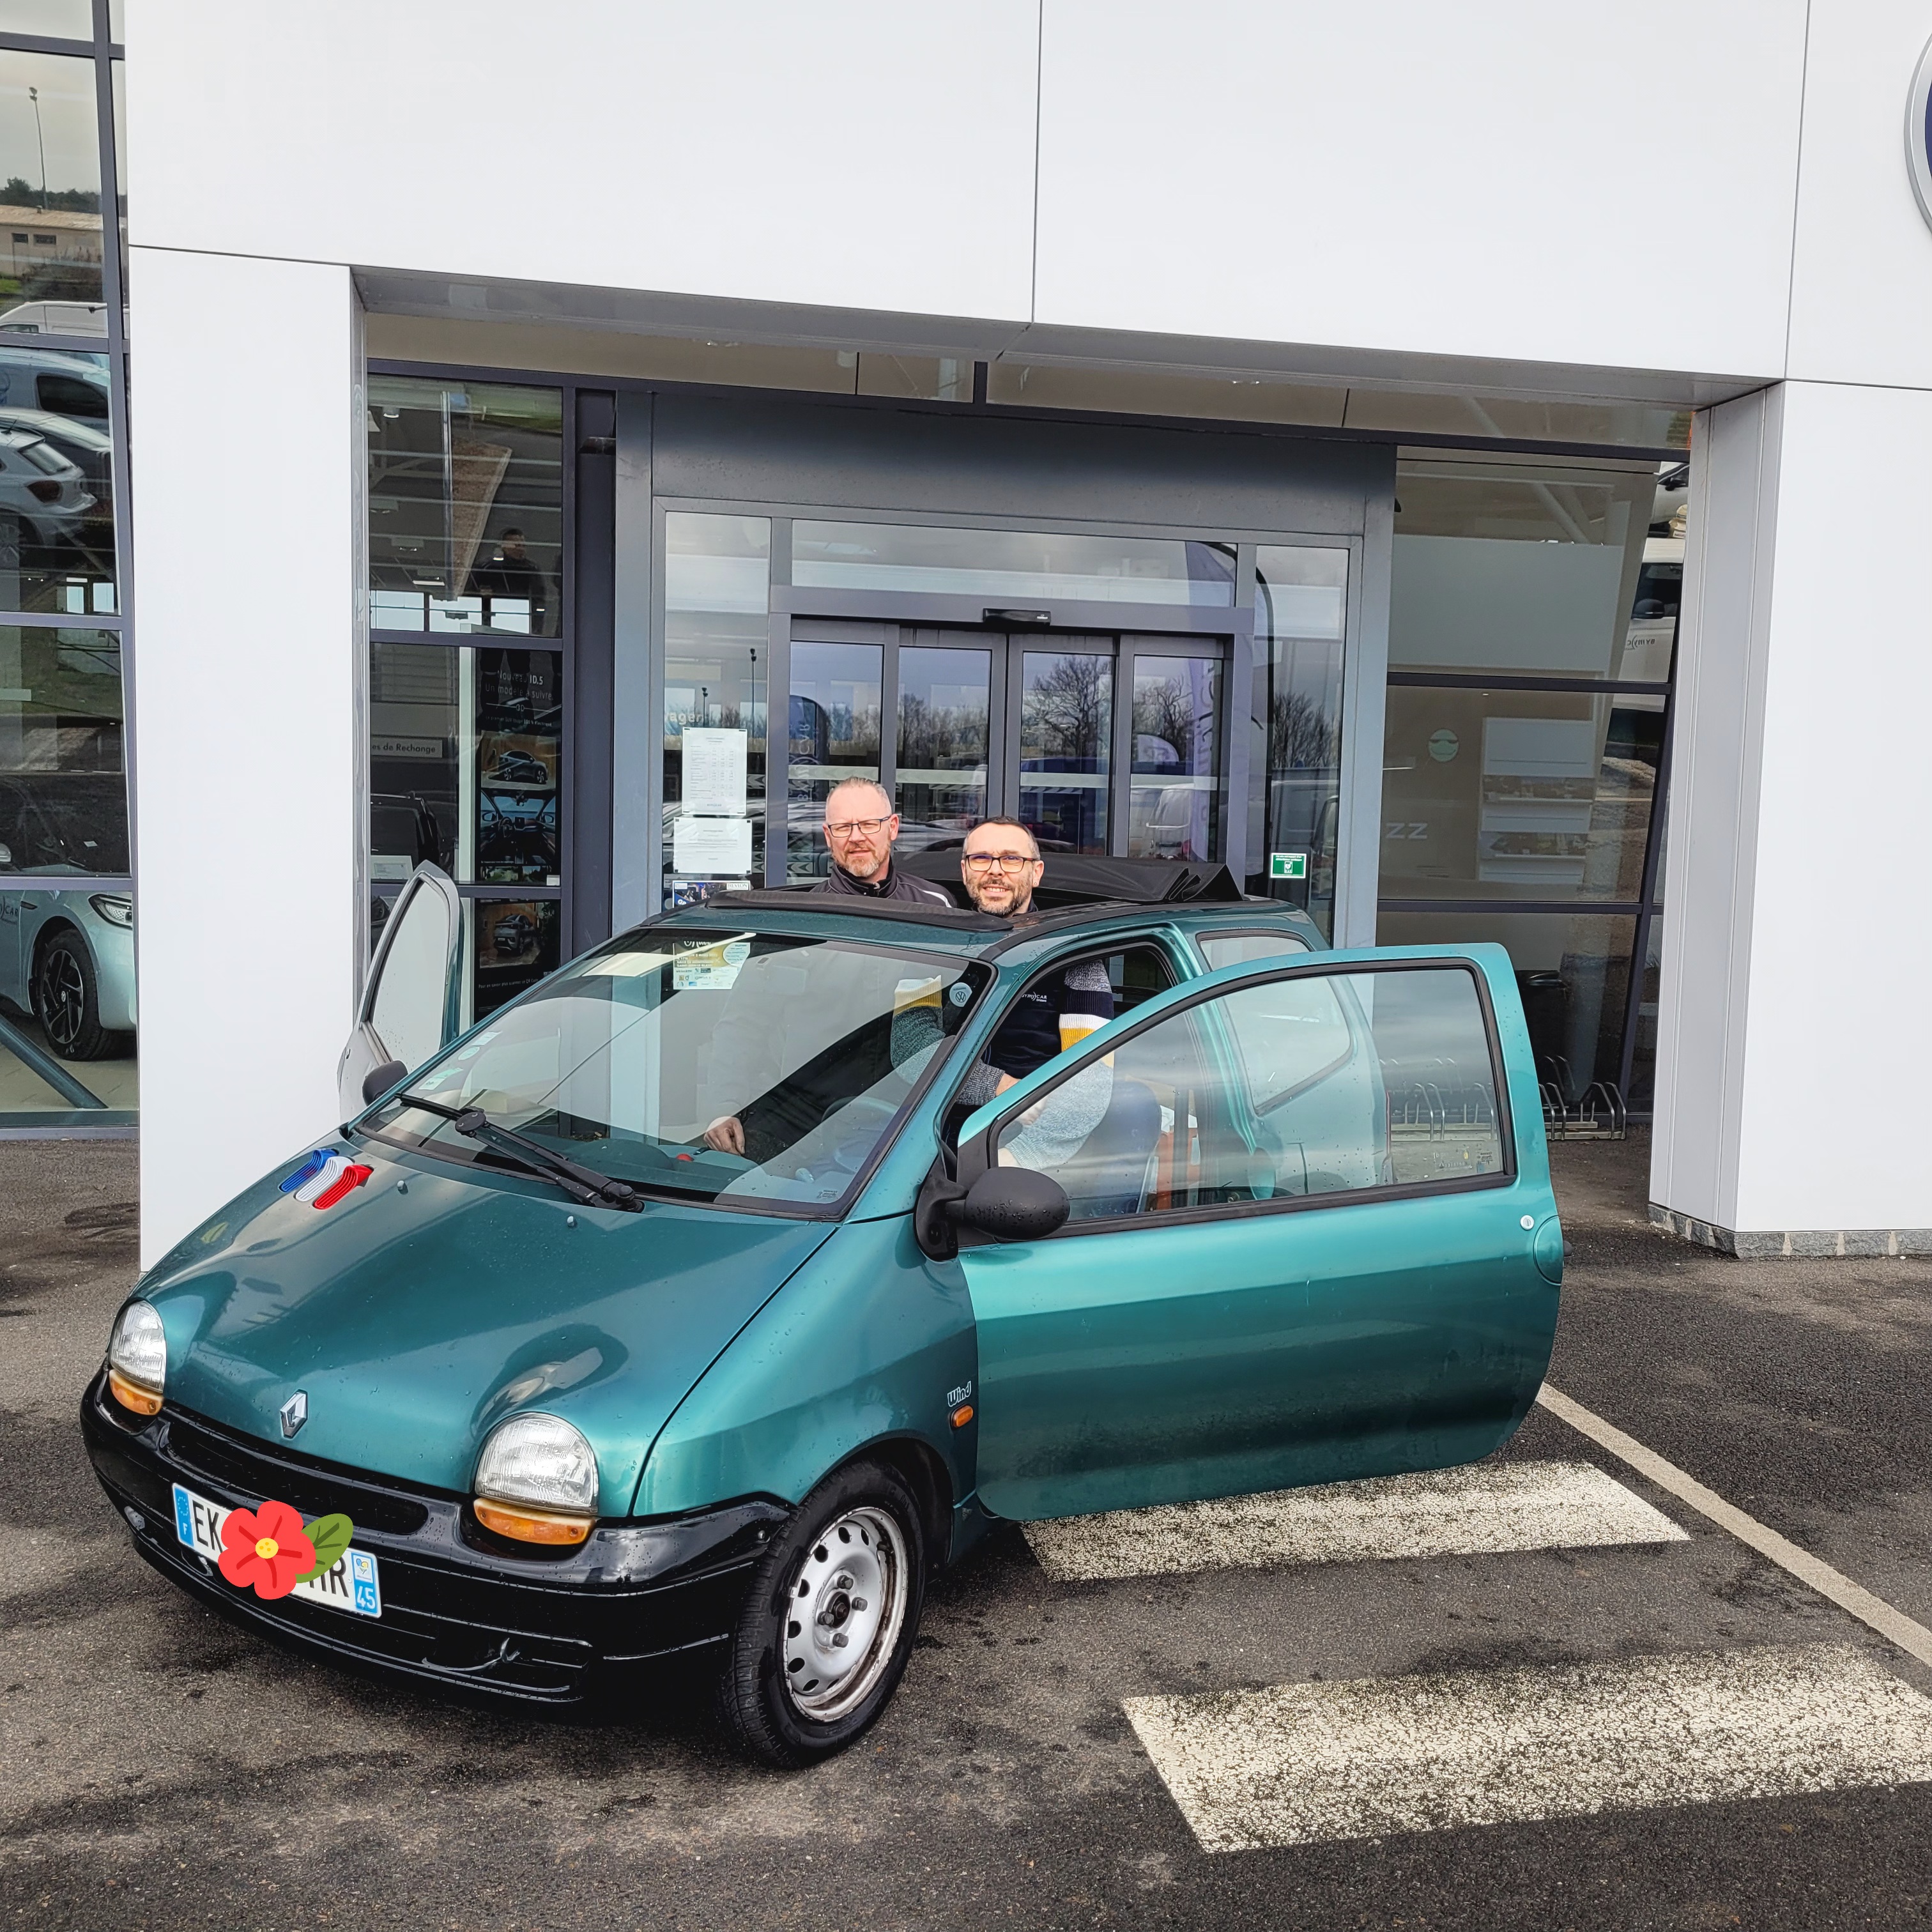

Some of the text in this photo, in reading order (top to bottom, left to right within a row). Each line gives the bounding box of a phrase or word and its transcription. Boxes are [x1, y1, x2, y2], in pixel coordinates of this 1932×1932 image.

[485, 683, 495, 692] Un
[530, 675, 544, 686] ID.5
[383, 742, 394, 751] de
[396, 742, 436, 754] Rechange
[947, 1380, 972, 1407] Wind
[182, 1522, 188, 1536] F
[192, 1499, 224, 1554] EK
[356, 1584, 376, 1611] 45
